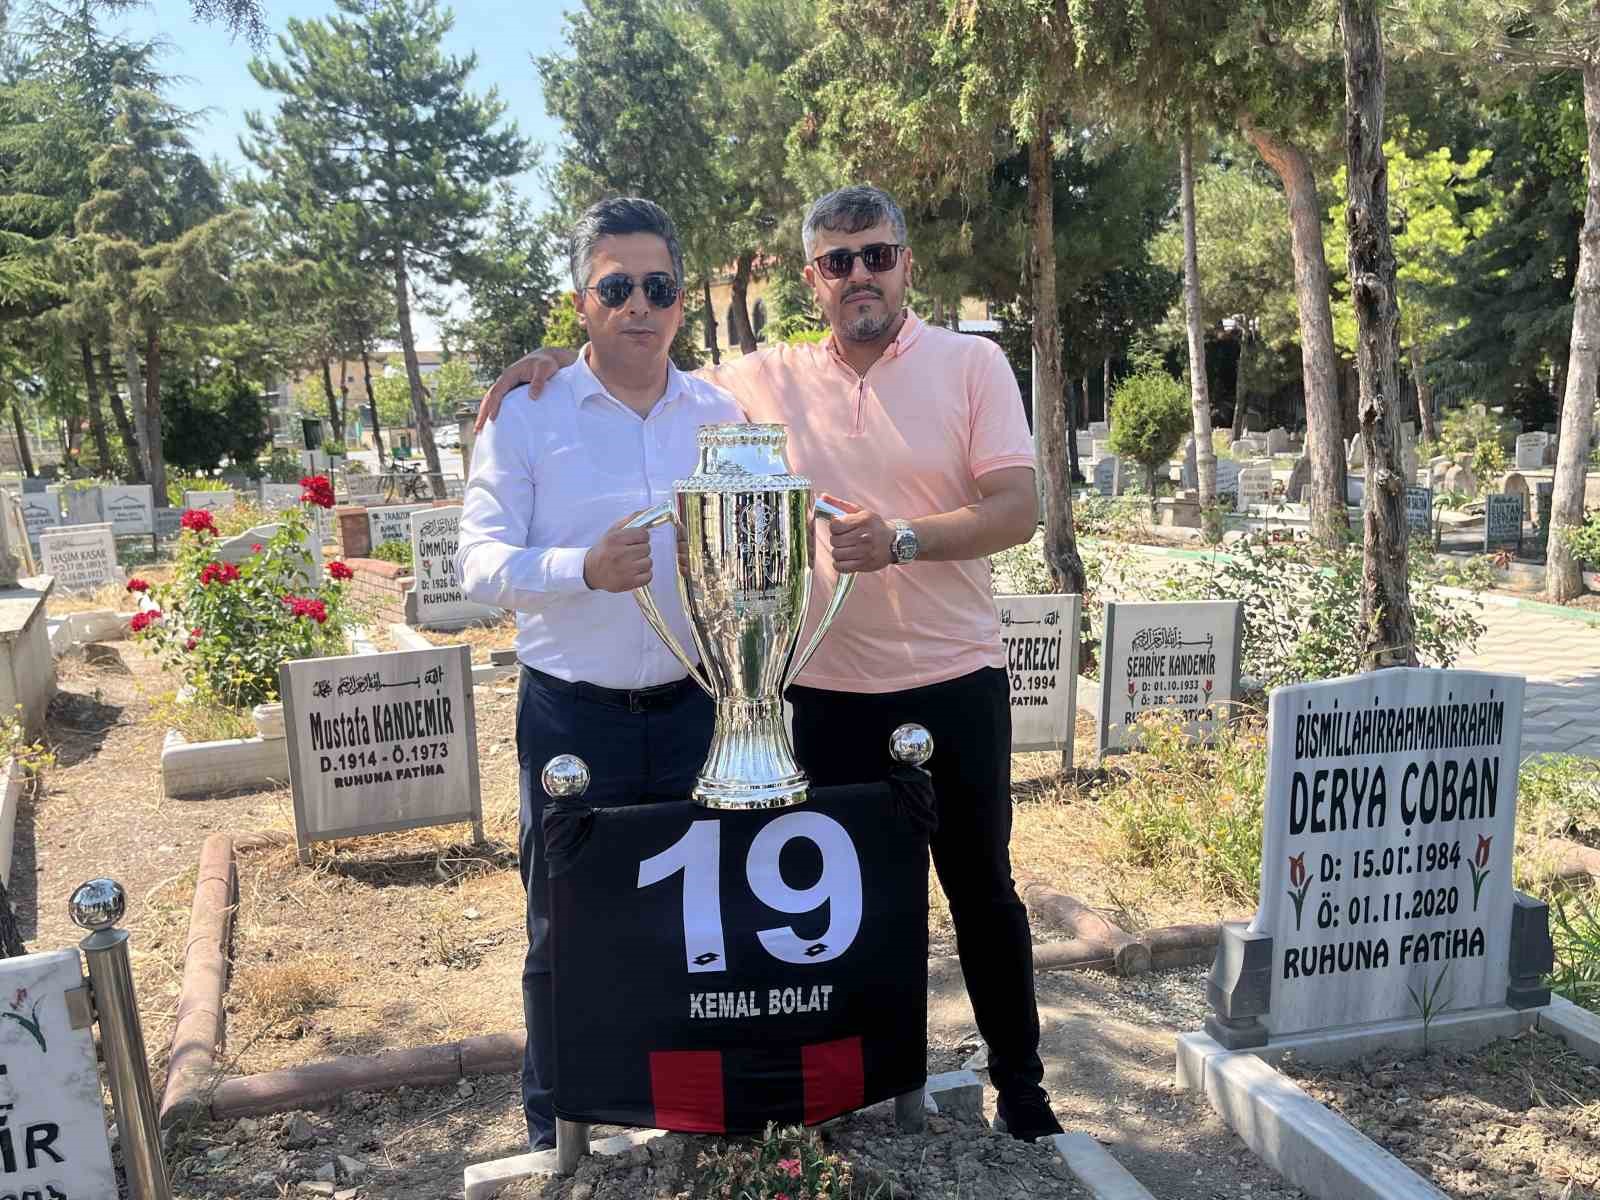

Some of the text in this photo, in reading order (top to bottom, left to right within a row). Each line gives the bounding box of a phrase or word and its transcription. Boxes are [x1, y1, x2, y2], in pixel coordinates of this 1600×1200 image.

[419, 538, 459, 557] ÜMMÜHA
[424, 592, 461, 605] RUHUNA
[1142, 682, 1151, 692] D:
[309, 690, 454, 751] Mustafa KANDEMİR
[1295, 689, 1504, 760] BİSMİLLAHİRRAHMANİRRAHİM
[320, 750, 377, 773] D.1914
[392, 742, 449, 765] Ö.1973
[334, 763, 445, 789] RUHUNA FATİHA
[1288, 756, 1499, 837] DERYA ÇOBAN
[1320, 840, 1461, 882] D: 15.01.1984
[637, 811, 863, 973] 19
[1317, 886, 1459, 929] Ö: 01.11.2020
[1283, 937, 1389, 980] RUHUNA
[689, 985, 832, 1018] KEMAL BOLAT
